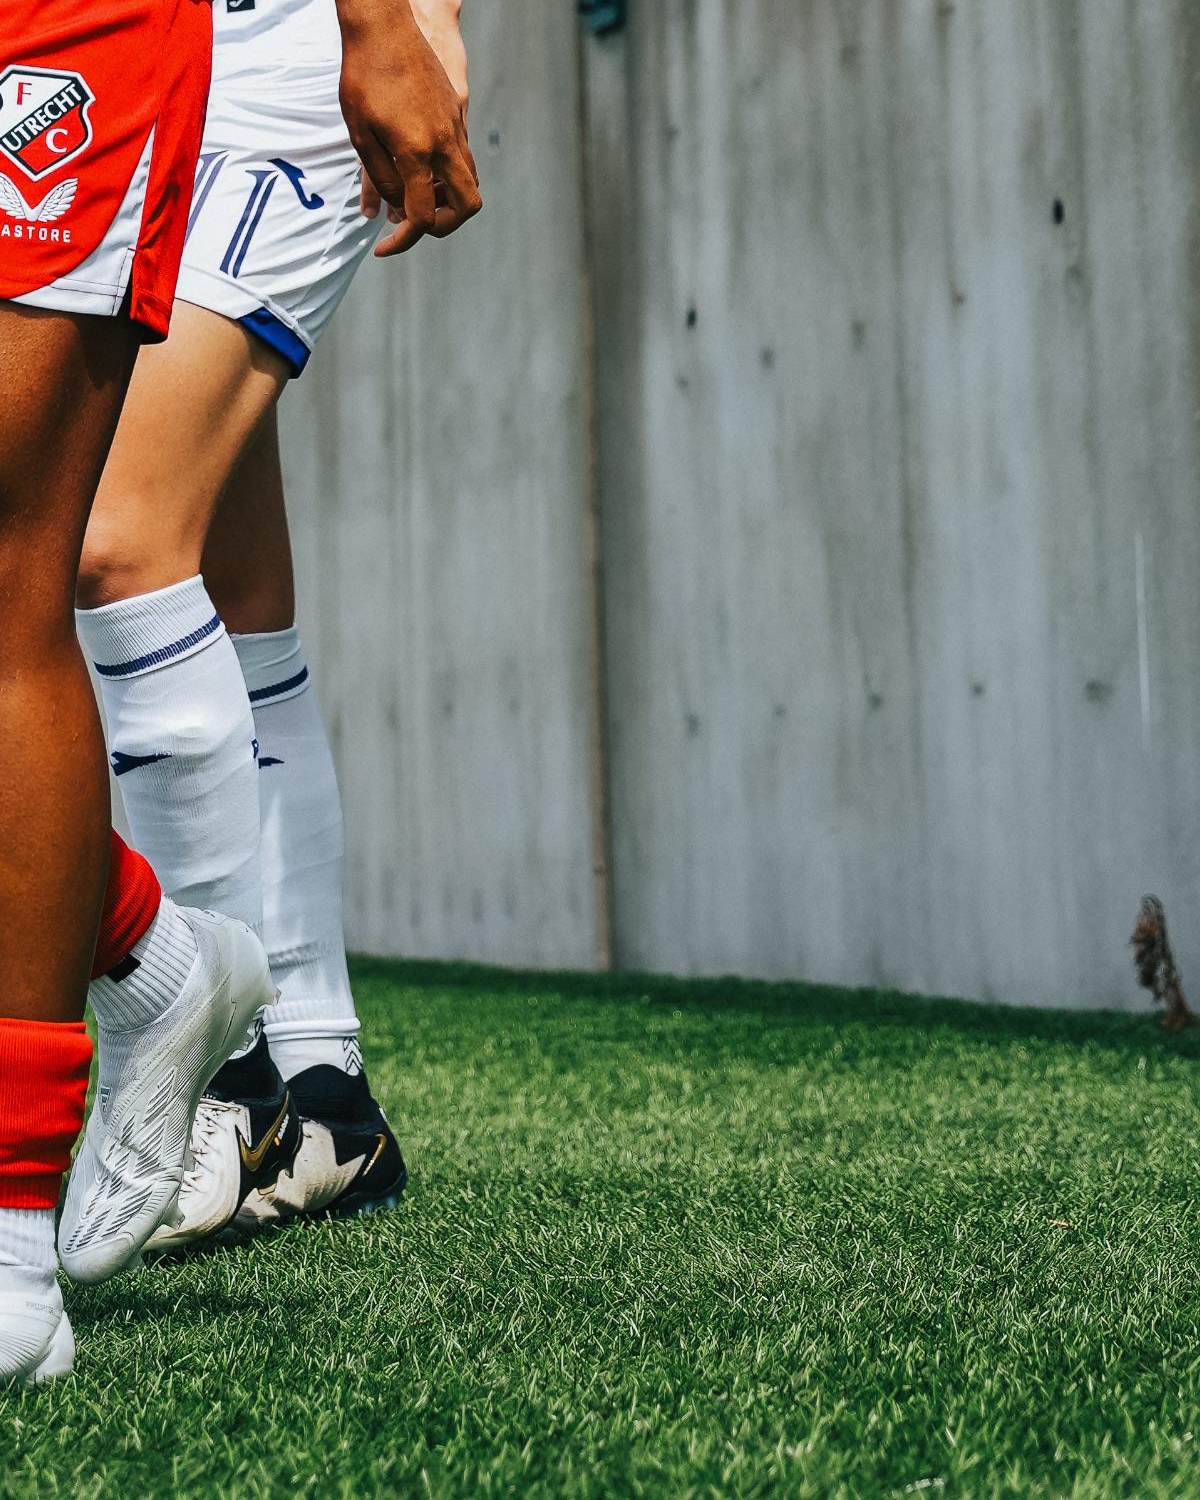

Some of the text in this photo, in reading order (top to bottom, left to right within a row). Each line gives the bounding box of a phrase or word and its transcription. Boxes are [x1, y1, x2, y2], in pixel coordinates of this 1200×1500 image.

[16, 81, 33, 106] F
[2, 83, 82, 152] UTRECHT
[45, 127, 69, 153] C
